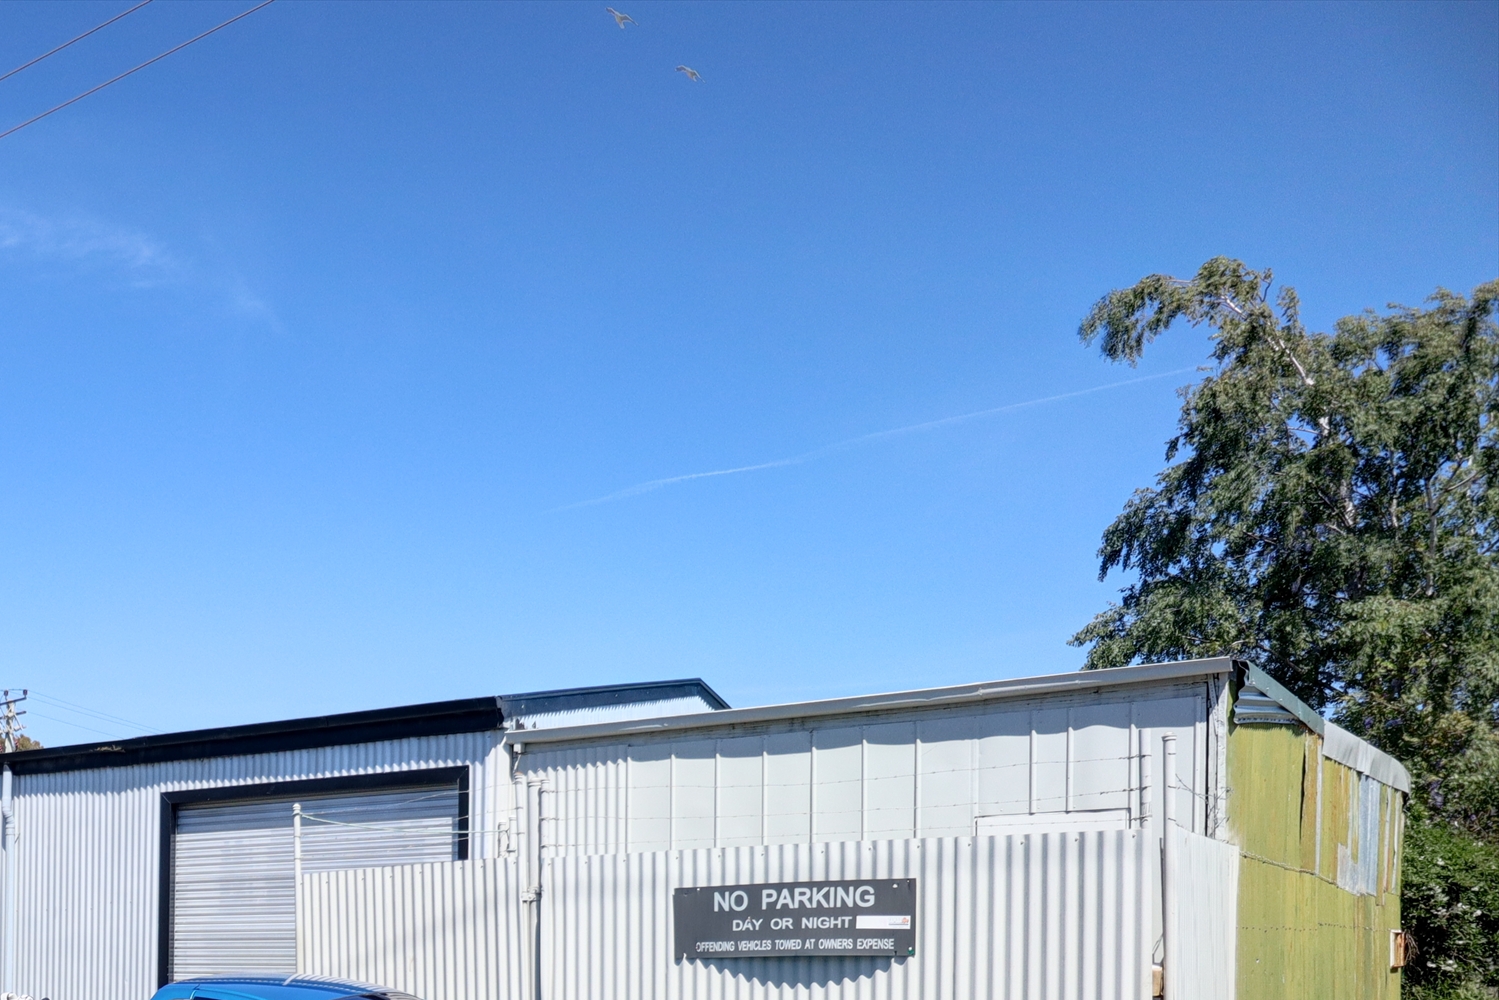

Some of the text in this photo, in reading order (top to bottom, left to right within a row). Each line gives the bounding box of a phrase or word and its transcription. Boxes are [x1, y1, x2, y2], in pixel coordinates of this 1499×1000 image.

[713, 885, 876, 912] NO PARKING
[732, 916, 853, 932] DAY OR NIGHT
[695, 938, 895, 952] OFFENDING VEHICLES TOWED AT OWNERS EXPENSE
